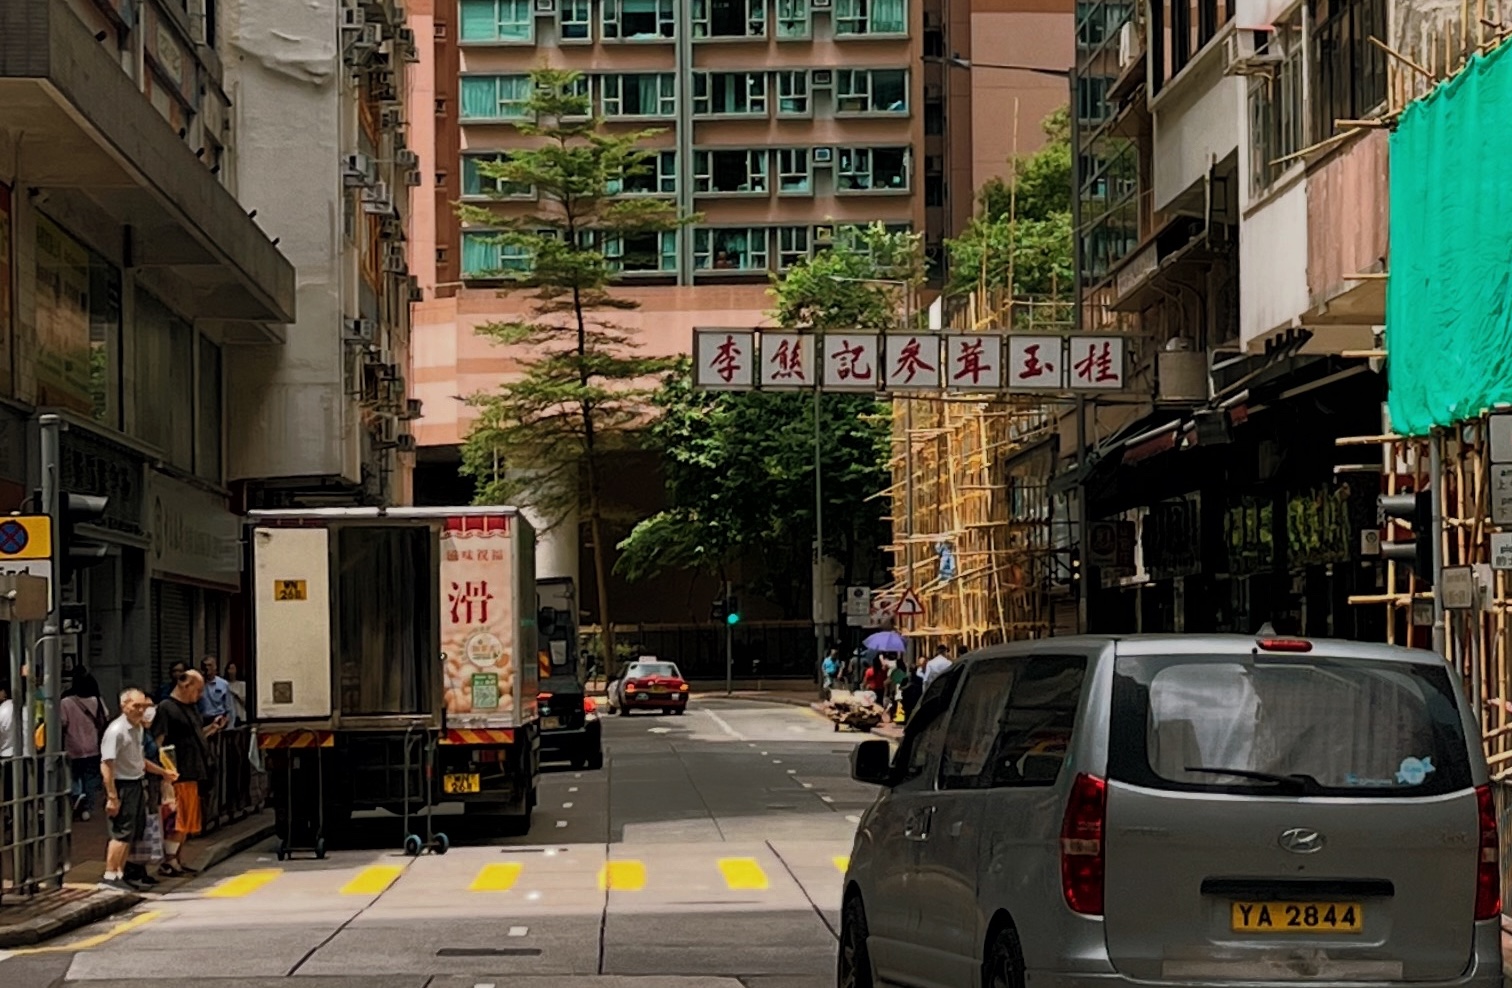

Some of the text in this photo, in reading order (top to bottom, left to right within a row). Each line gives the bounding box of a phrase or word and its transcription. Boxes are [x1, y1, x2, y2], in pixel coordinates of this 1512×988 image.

[709, 335, 1120, 384] 李熊記參茸玉桂
[1239, 905, 1356, 927] YA 2844
